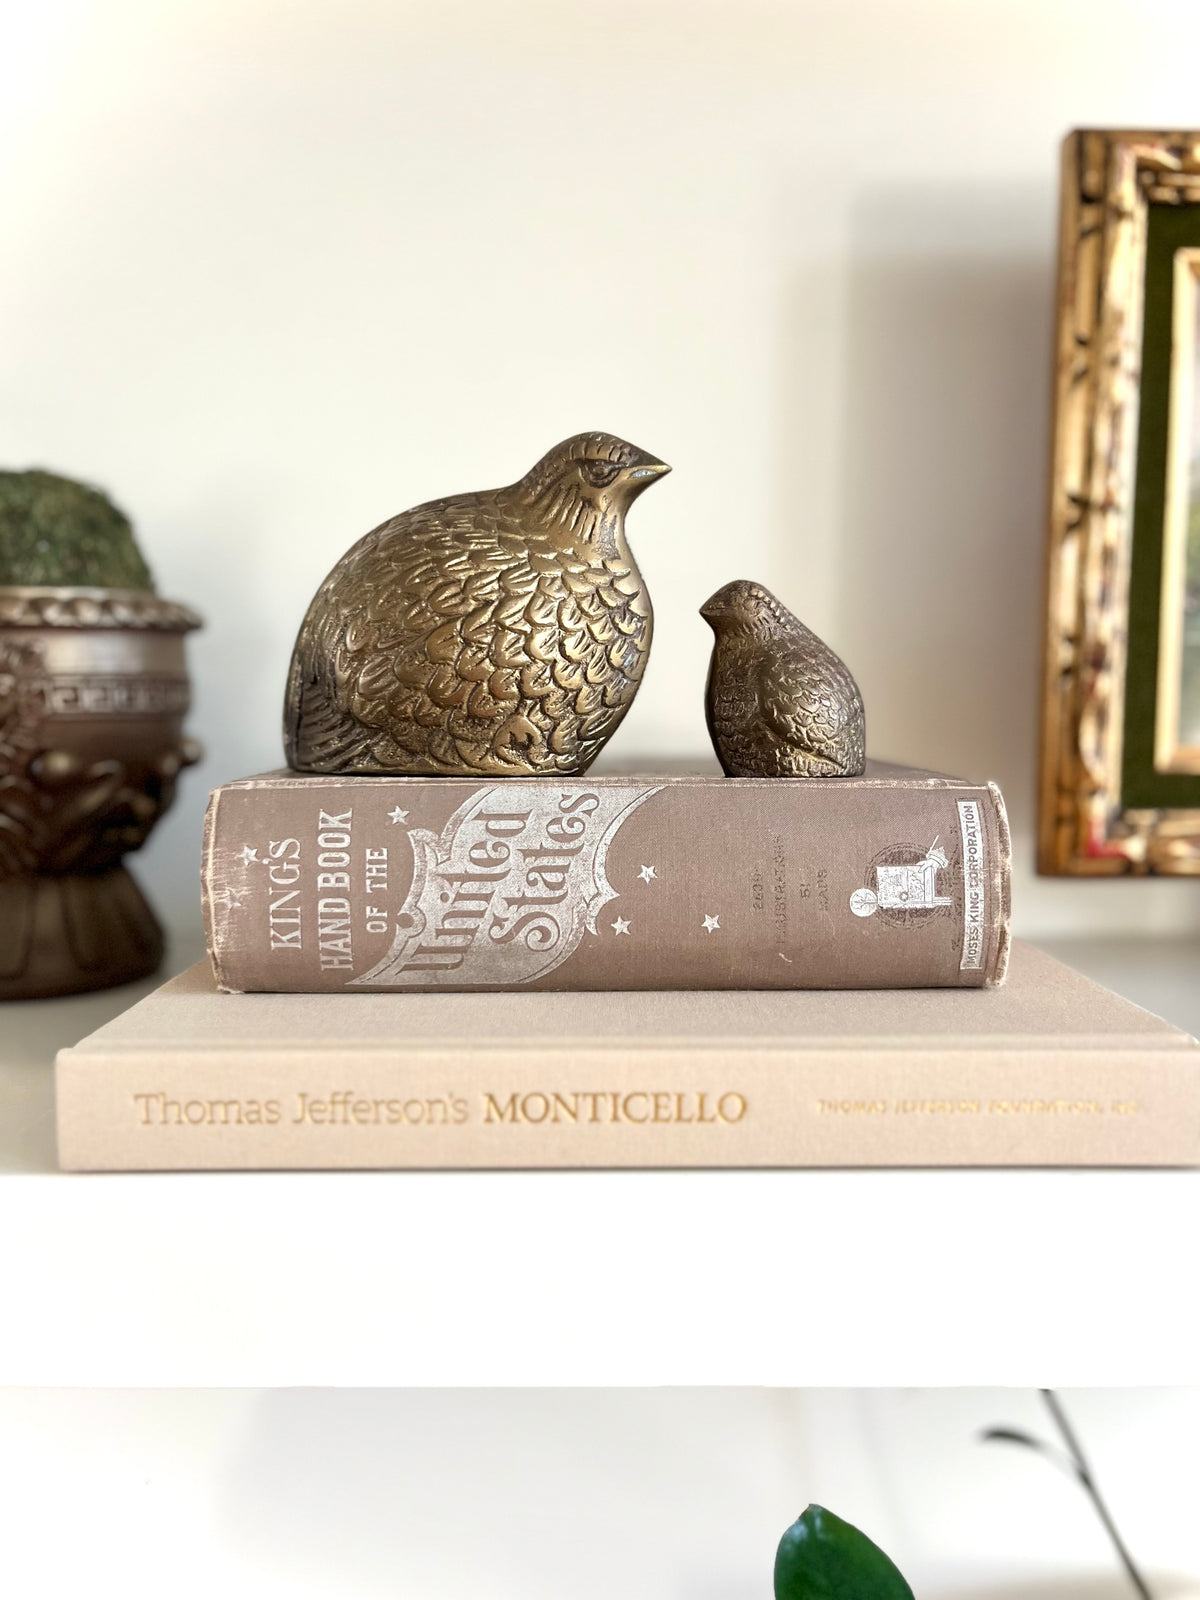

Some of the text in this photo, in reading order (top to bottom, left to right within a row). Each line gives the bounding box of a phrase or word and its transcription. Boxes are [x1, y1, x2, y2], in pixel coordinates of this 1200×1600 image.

[262, 838, 302, 950] KING'S
[317, 808, 354, 971] HAND BOOK
[366, 847, 388, 933] OF THE
[395, 809, 532, 975] United
[489, 792, 600, 951] States
[964, 805, 979, 964] MOSES KING CORPORATION
[135, 1092, 748, 1126] Thomas Jefferson's MONTICELLO
[818, 1100, 887, 1114] THOMAS
